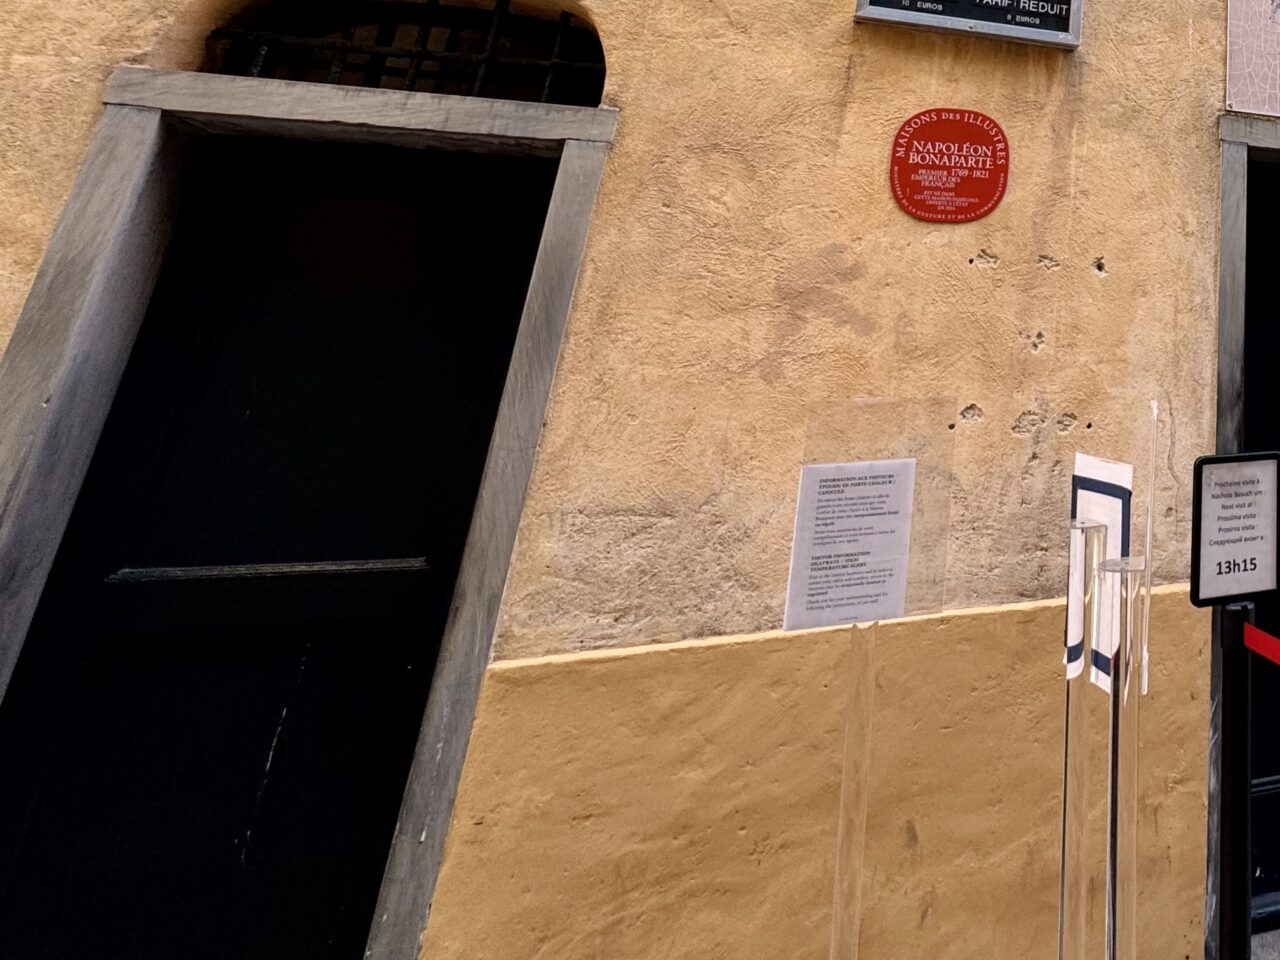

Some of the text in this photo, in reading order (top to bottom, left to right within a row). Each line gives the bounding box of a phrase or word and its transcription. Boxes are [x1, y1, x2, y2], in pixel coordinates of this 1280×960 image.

[917, 1, 943, 10] EUROS
[1020, 0, 1069, 15] REDUIT
[1015, 15, 1040, 24] EUROS
[895, 111, 1006, 165] MAISONS DES ILLUSTRES
[911, 140, 993, 157] NAPOLÉON
[908, 153, 994, 169] BONAPARTE
[1216, 556, 1257, 576] 13h15
